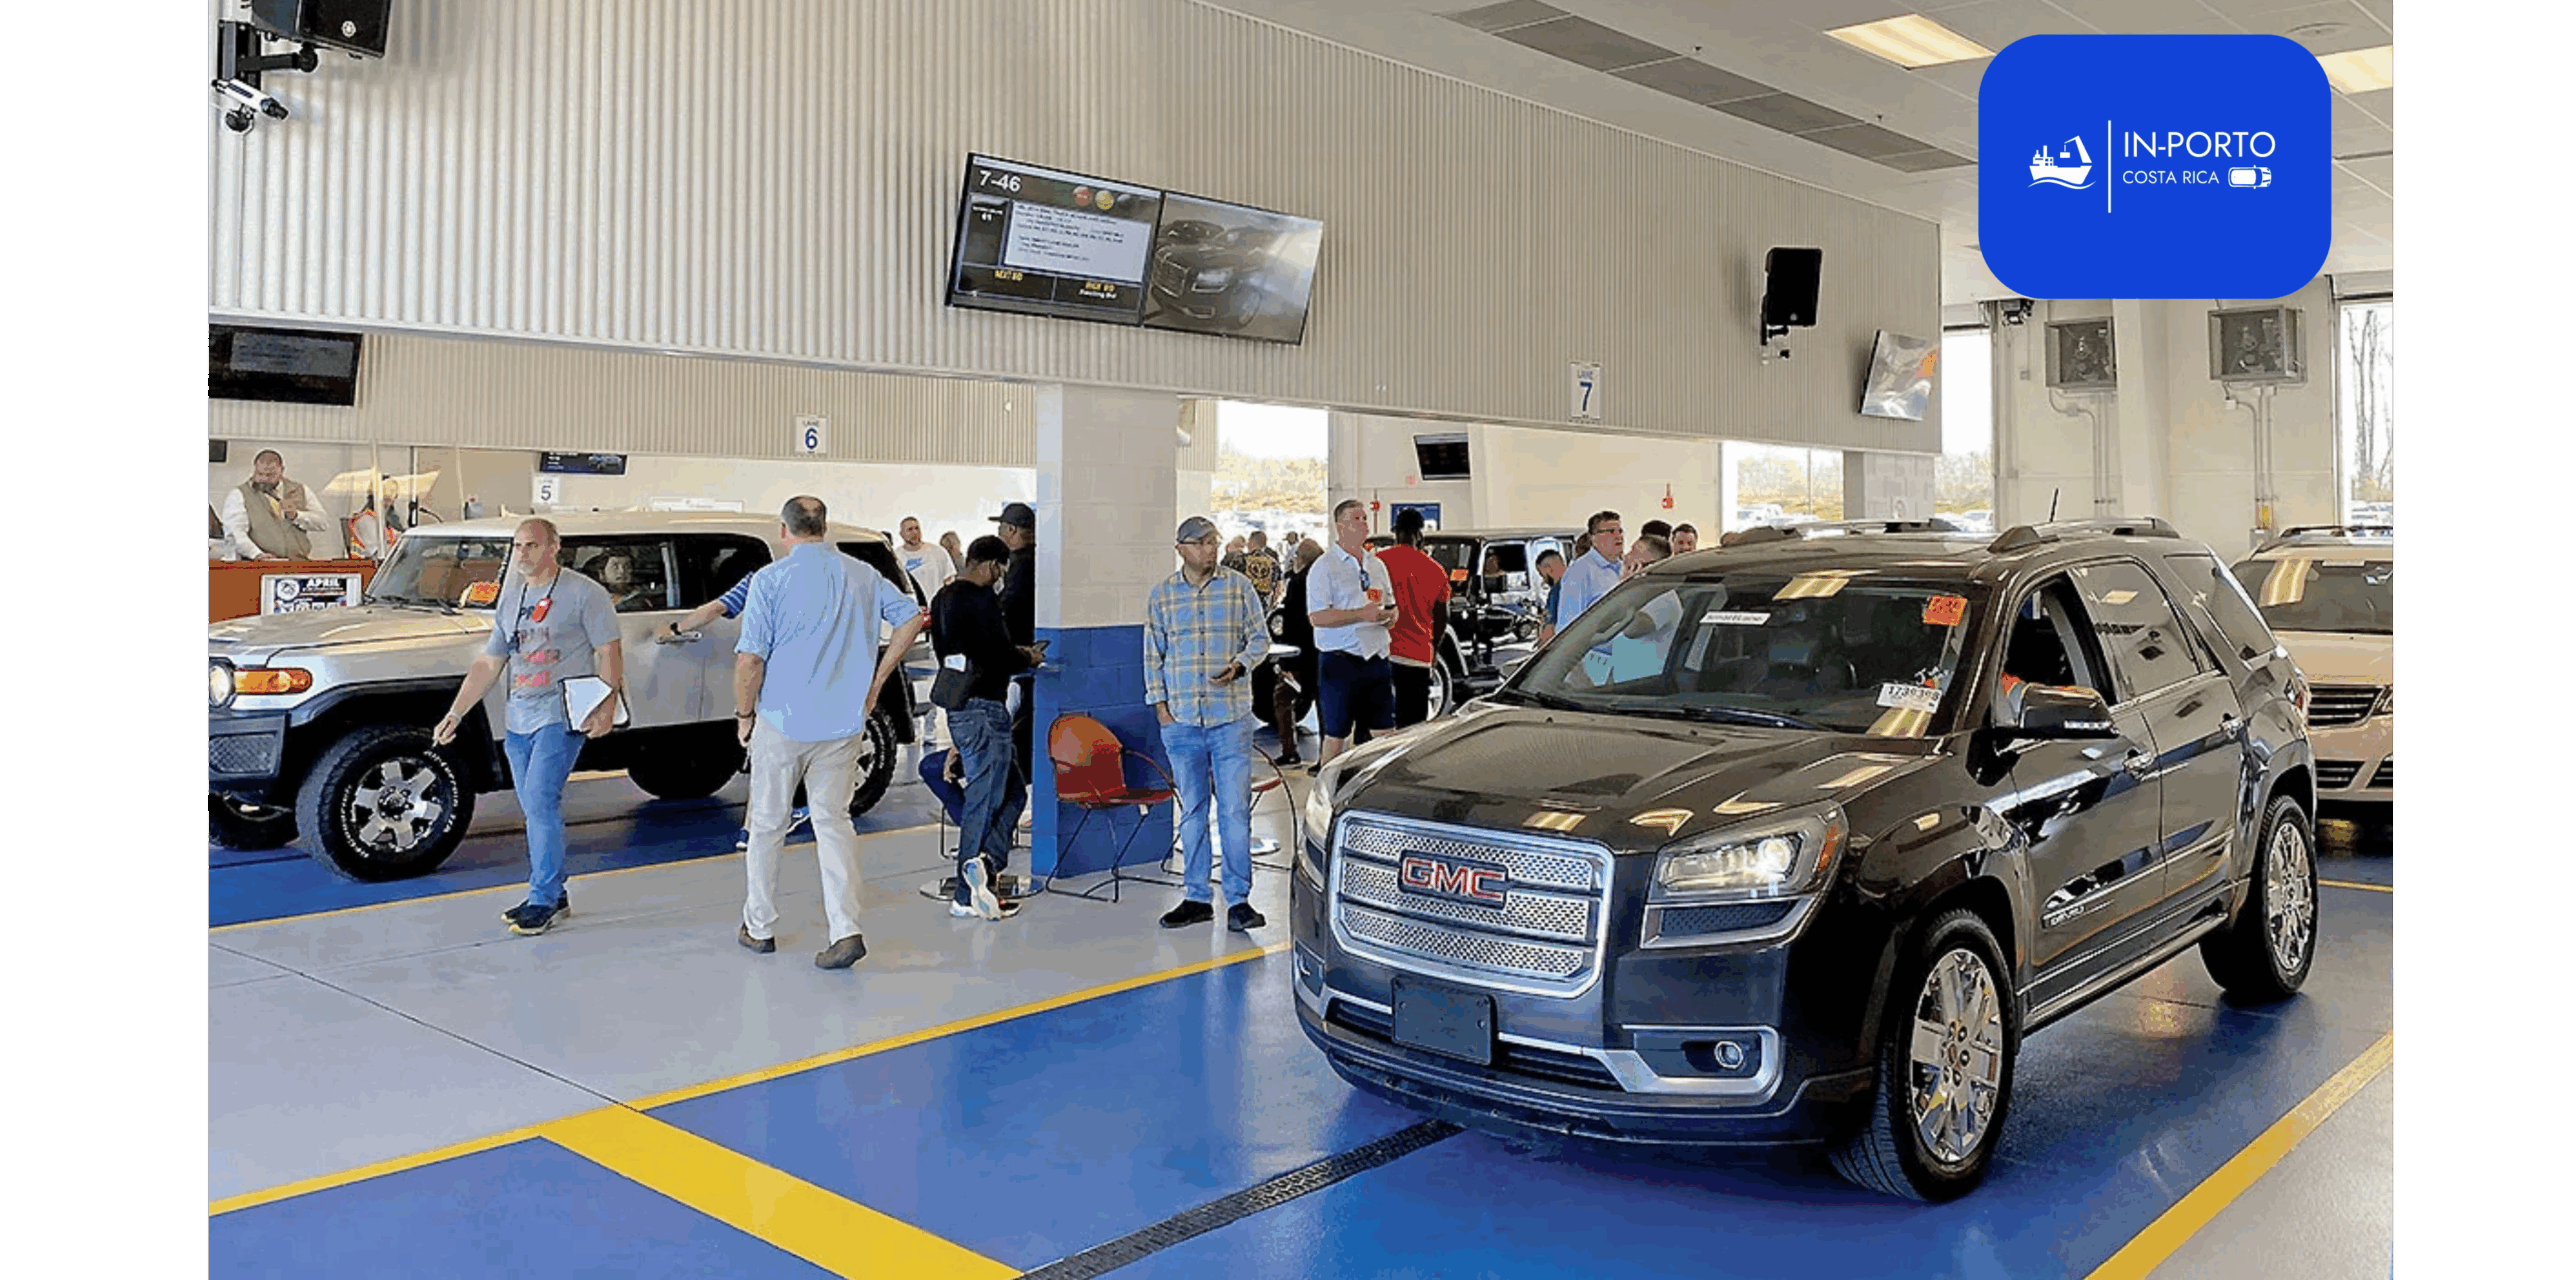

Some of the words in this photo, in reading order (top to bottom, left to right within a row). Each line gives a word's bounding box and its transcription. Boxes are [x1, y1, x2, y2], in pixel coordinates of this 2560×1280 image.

[978, 170, 1022, 192] 7-46
[1579, 381, 1593, 412] 7
[805, 428, 818, 450] 6
[541, 485, 552, 501] 5
[1402, 857, 1504, 900] GMC
